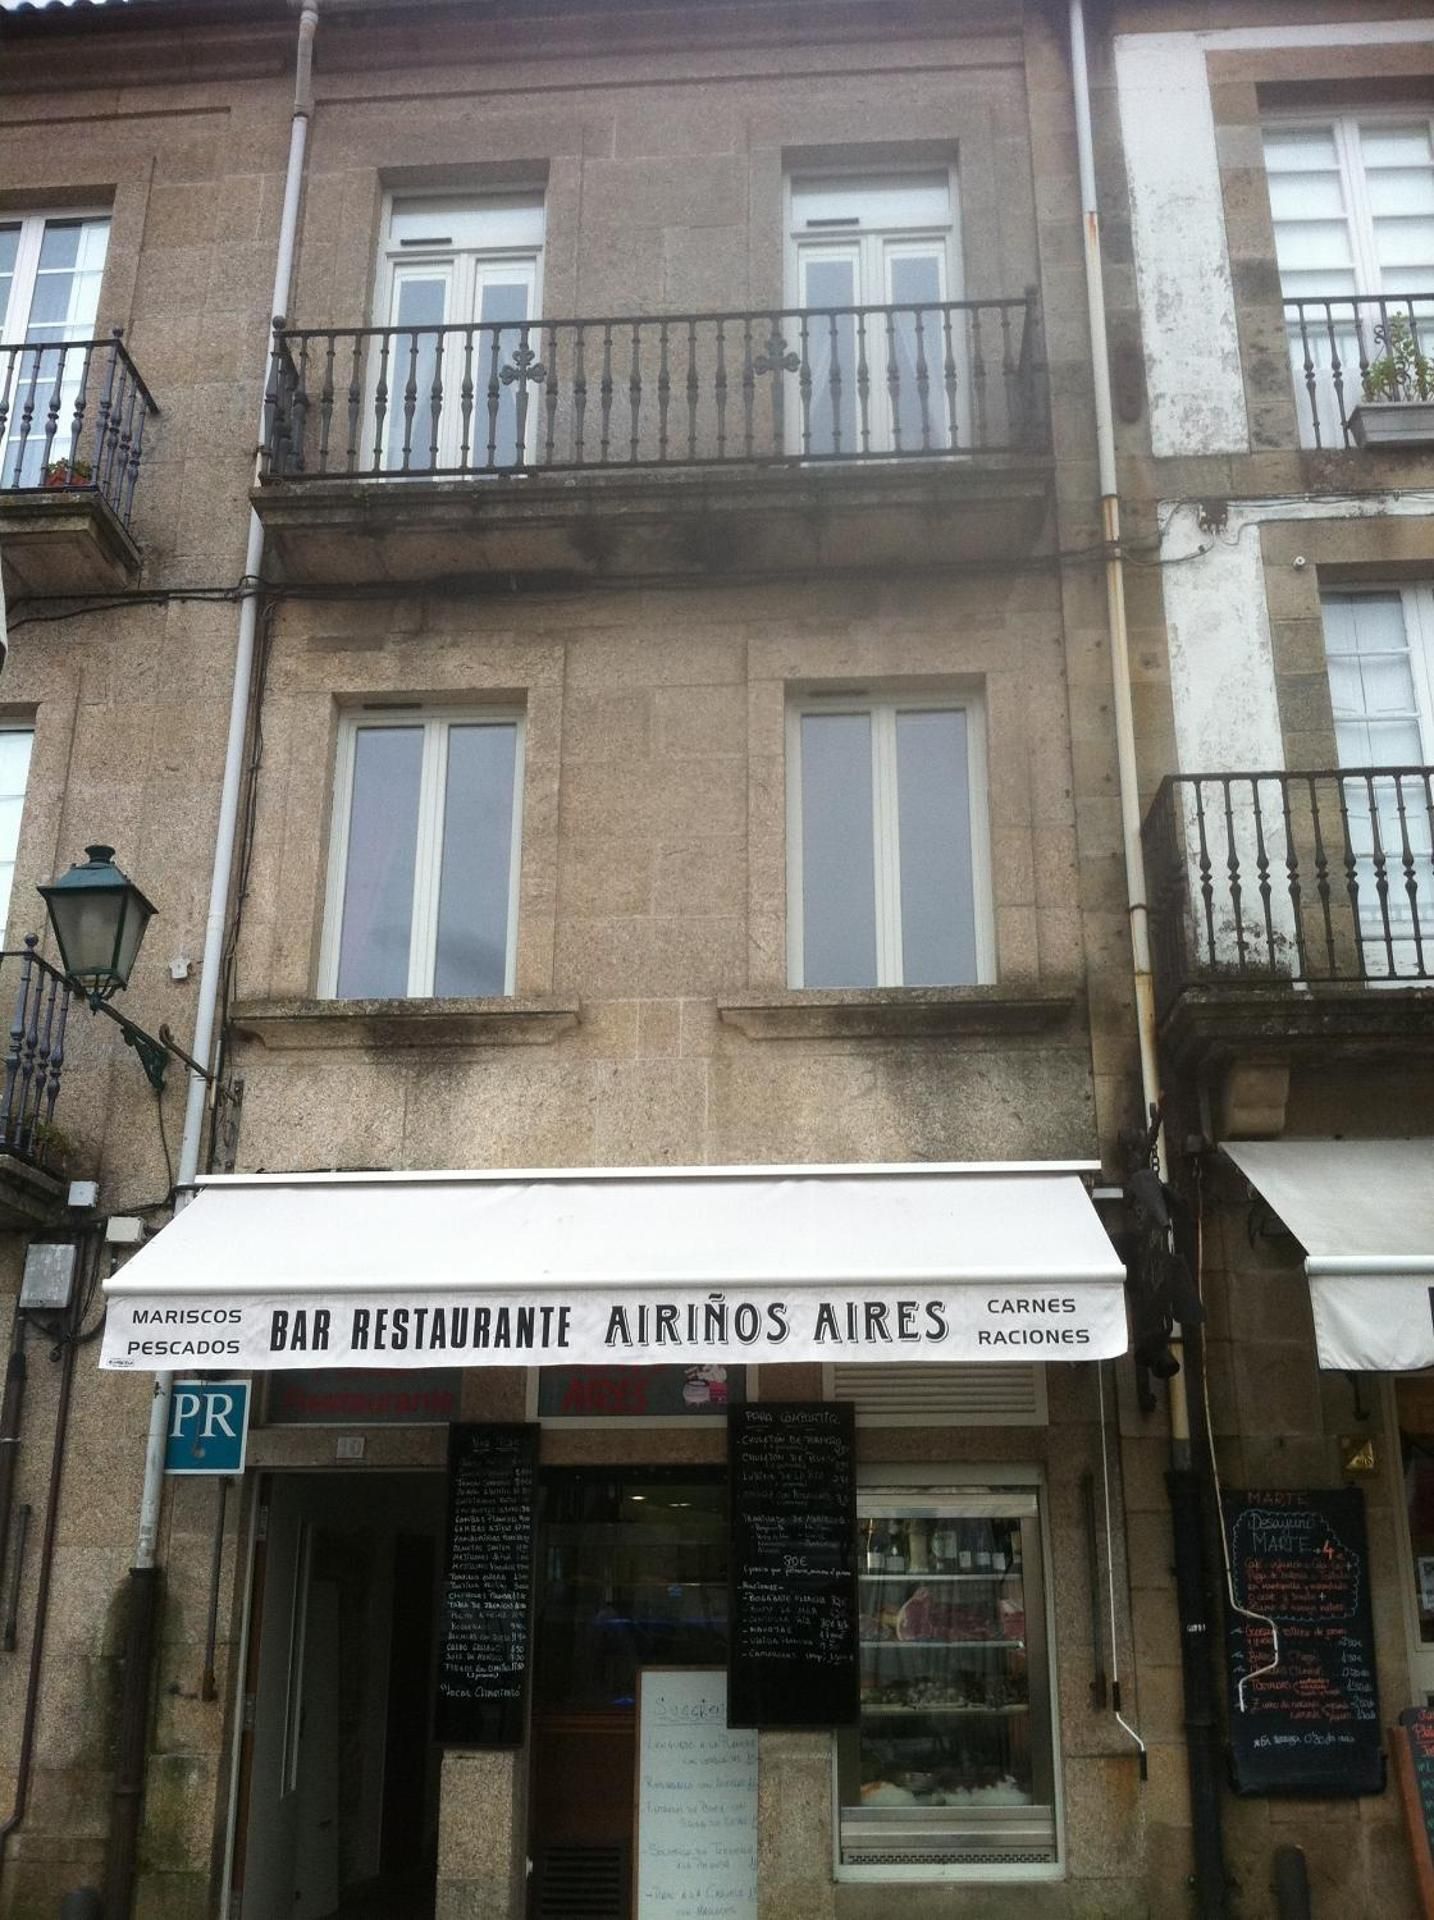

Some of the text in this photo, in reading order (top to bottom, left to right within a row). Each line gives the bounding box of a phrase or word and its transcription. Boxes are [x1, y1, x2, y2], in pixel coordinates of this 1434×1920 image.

[988, 1298, 1076, 1314] CARNES
[132, 1309, 242, 1324] MARISCOS
[270, 1293, 951, 1351] BAR RESTAURANTE AIRIÑOS AIRES
[978, 1329, 1090, 1346] RACIONES
[127, 1340, 240, 1355] PESCADOS
[168, 1393, 237, 1437] PR
